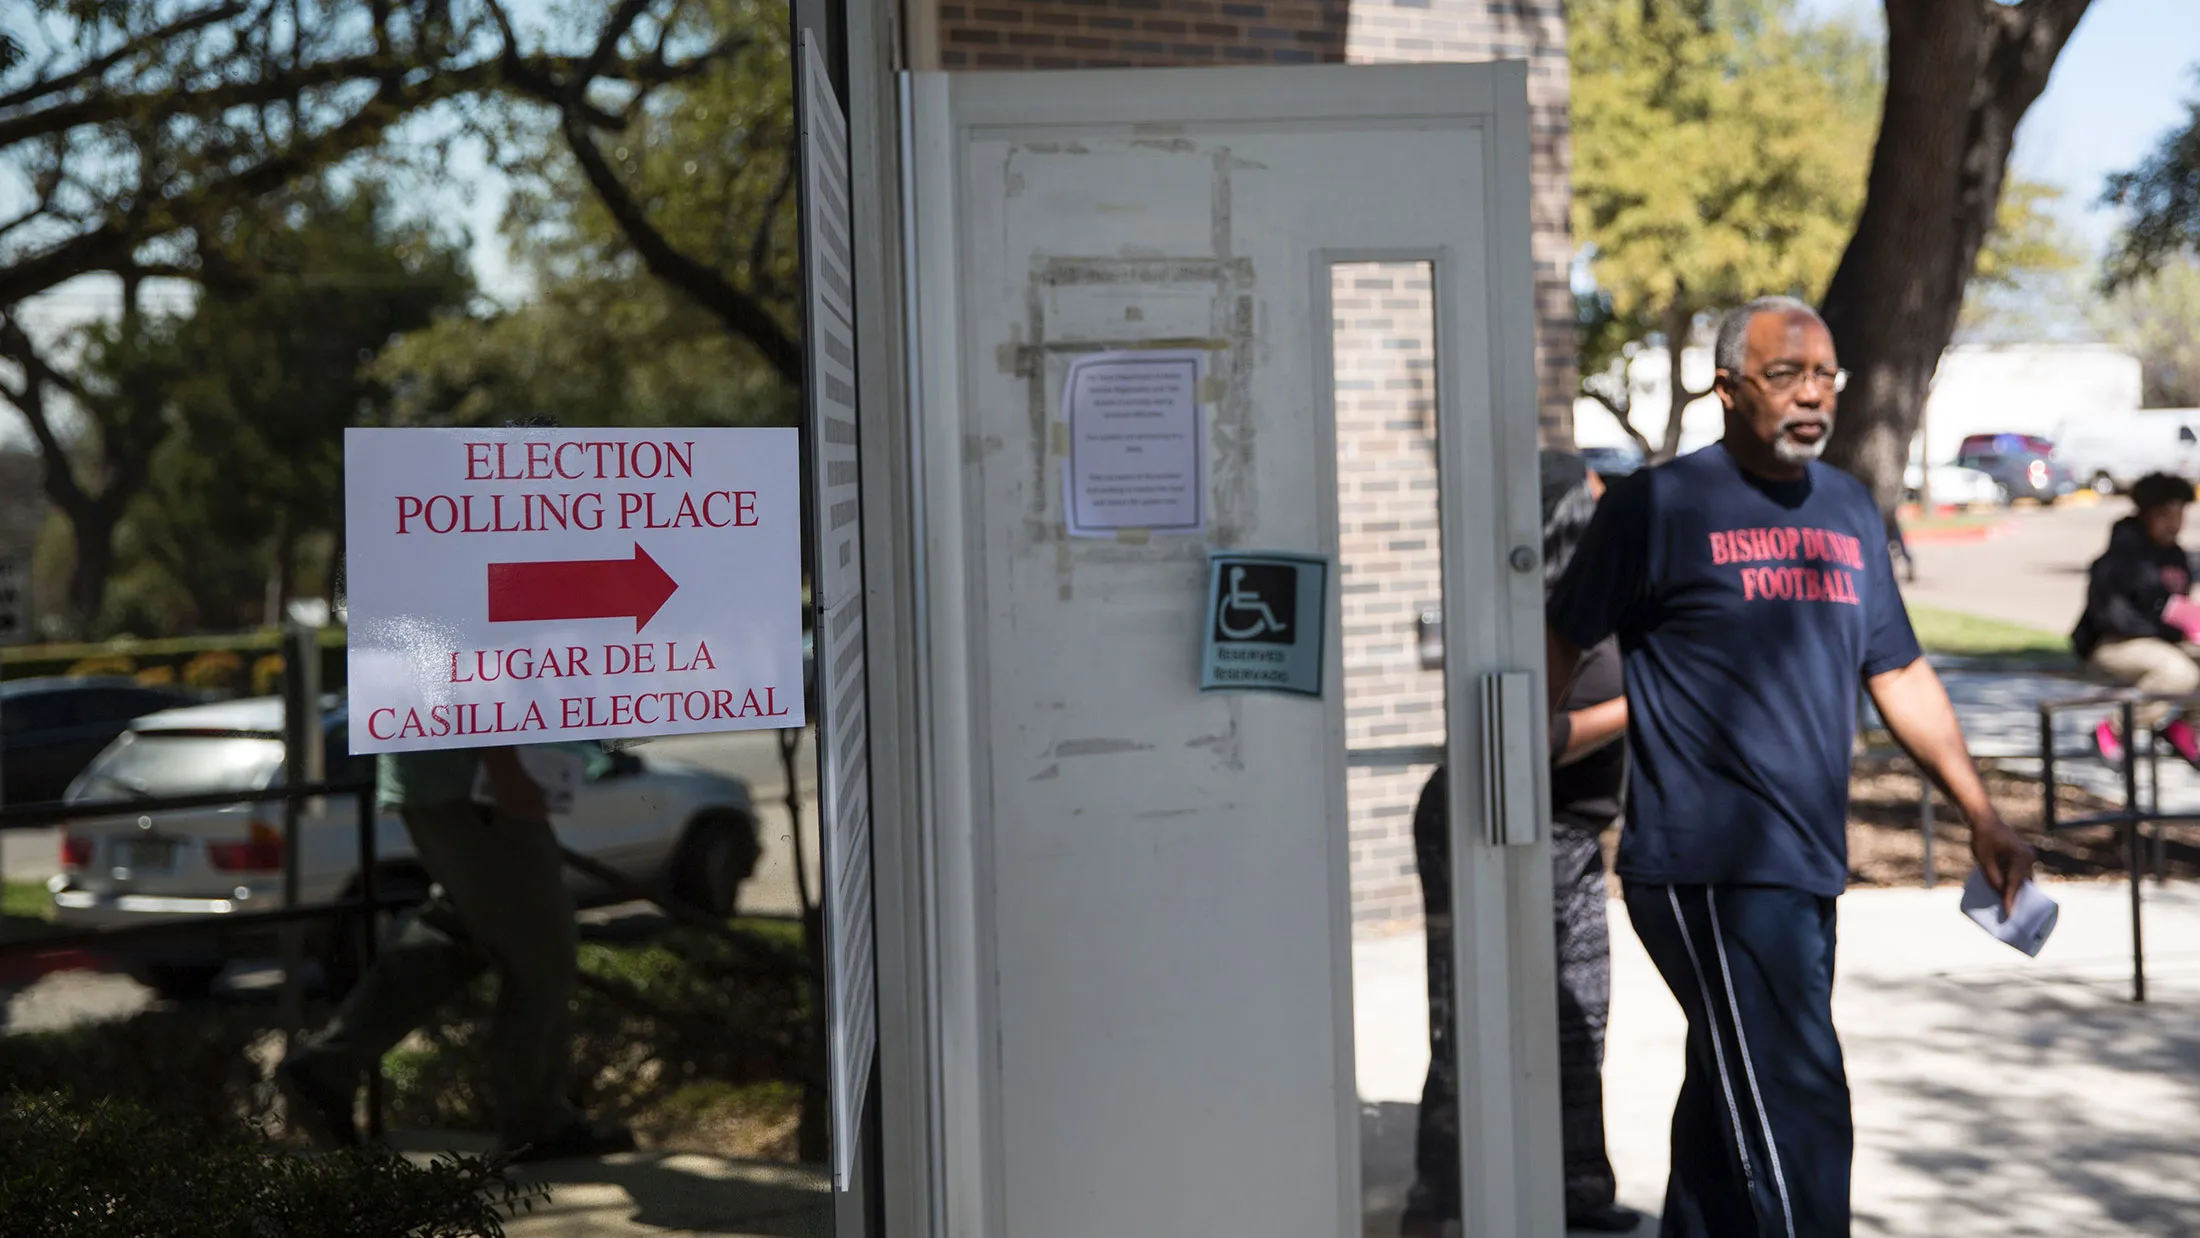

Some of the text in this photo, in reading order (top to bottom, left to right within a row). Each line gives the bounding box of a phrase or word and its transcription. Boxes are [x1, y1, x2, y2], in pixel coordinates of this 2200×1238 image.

[465, 441, 694, 480] ELECTION
[396, 490, 759, 534] POLLING PLACE
[1709, 526, 1800, 565] BISHOP
[1740, 566, 1860, 605] FOOTBALL
[449, 640, 716, 683] LUGAR DE LA
[367, 686, 789, 741] CASILLA ELECTORAL
